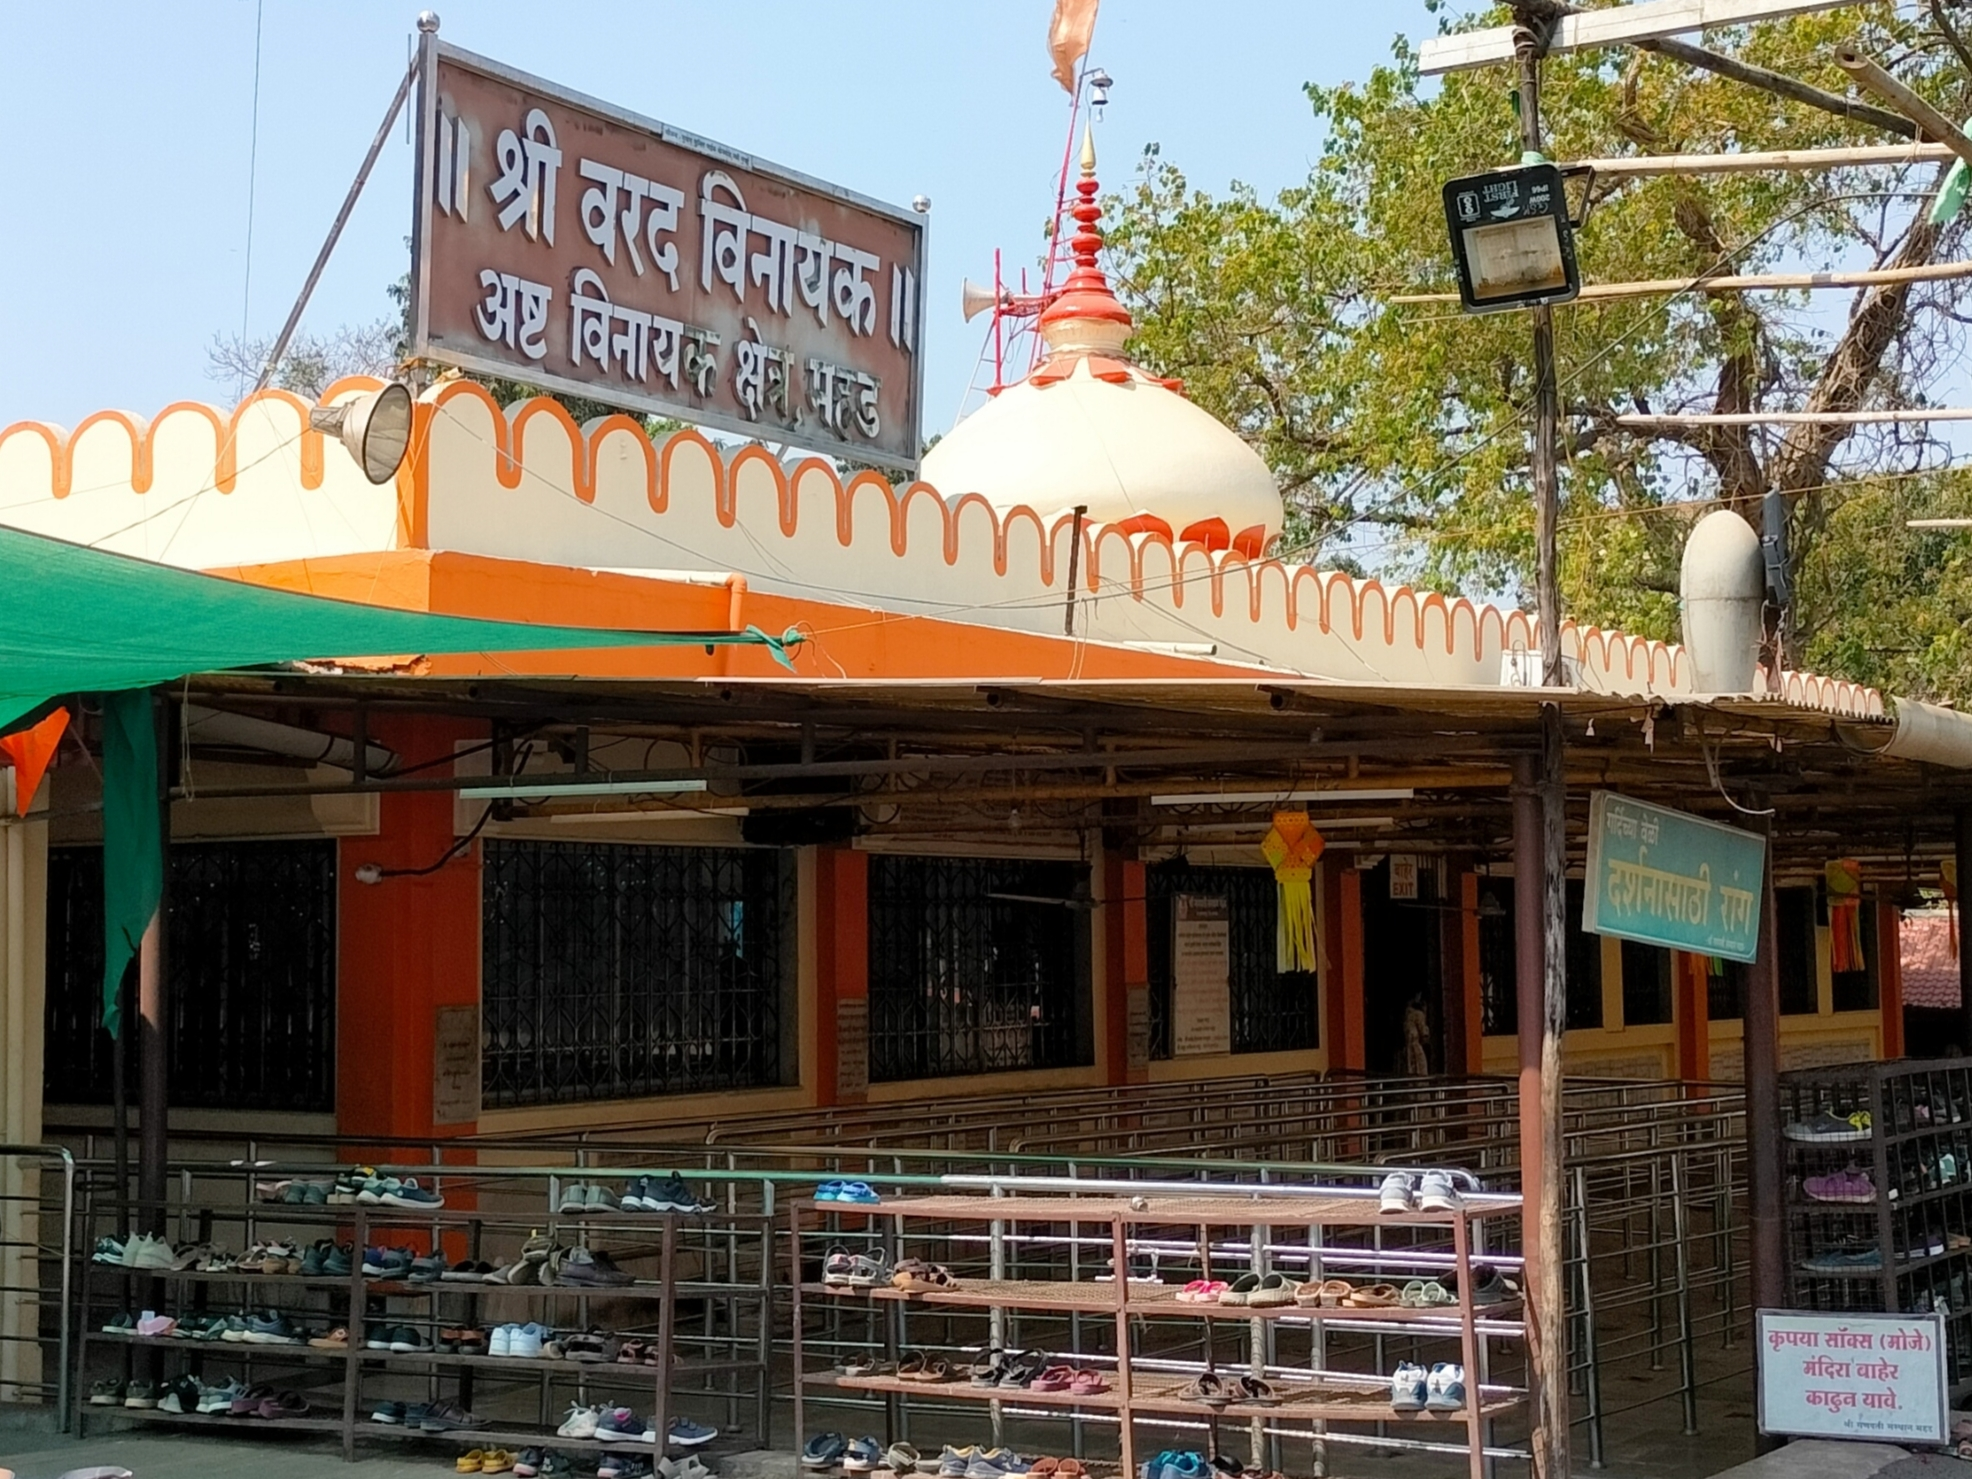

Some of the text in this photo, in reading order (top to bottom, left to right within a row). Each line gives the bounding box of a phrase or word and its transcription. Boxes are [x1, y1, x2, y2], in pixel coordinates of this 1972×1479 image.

[1482, 180, 1518, 195] LIGHT
[490, 108, 563, 248] श्री
[579, 158, 685, 292] वरद
[698, 169, 881, 338] विनायक
[475, 267, 553, 361] अष्ट
[569, 265, 722, 398] विनायक
[1393, 882, 1414, 896] EXIT
[1607, 844, 1754, 935] दर्शनासाठी रांग
[1767, 1327, 1932, 1352] कृपया सॉक्स (मोजे)
